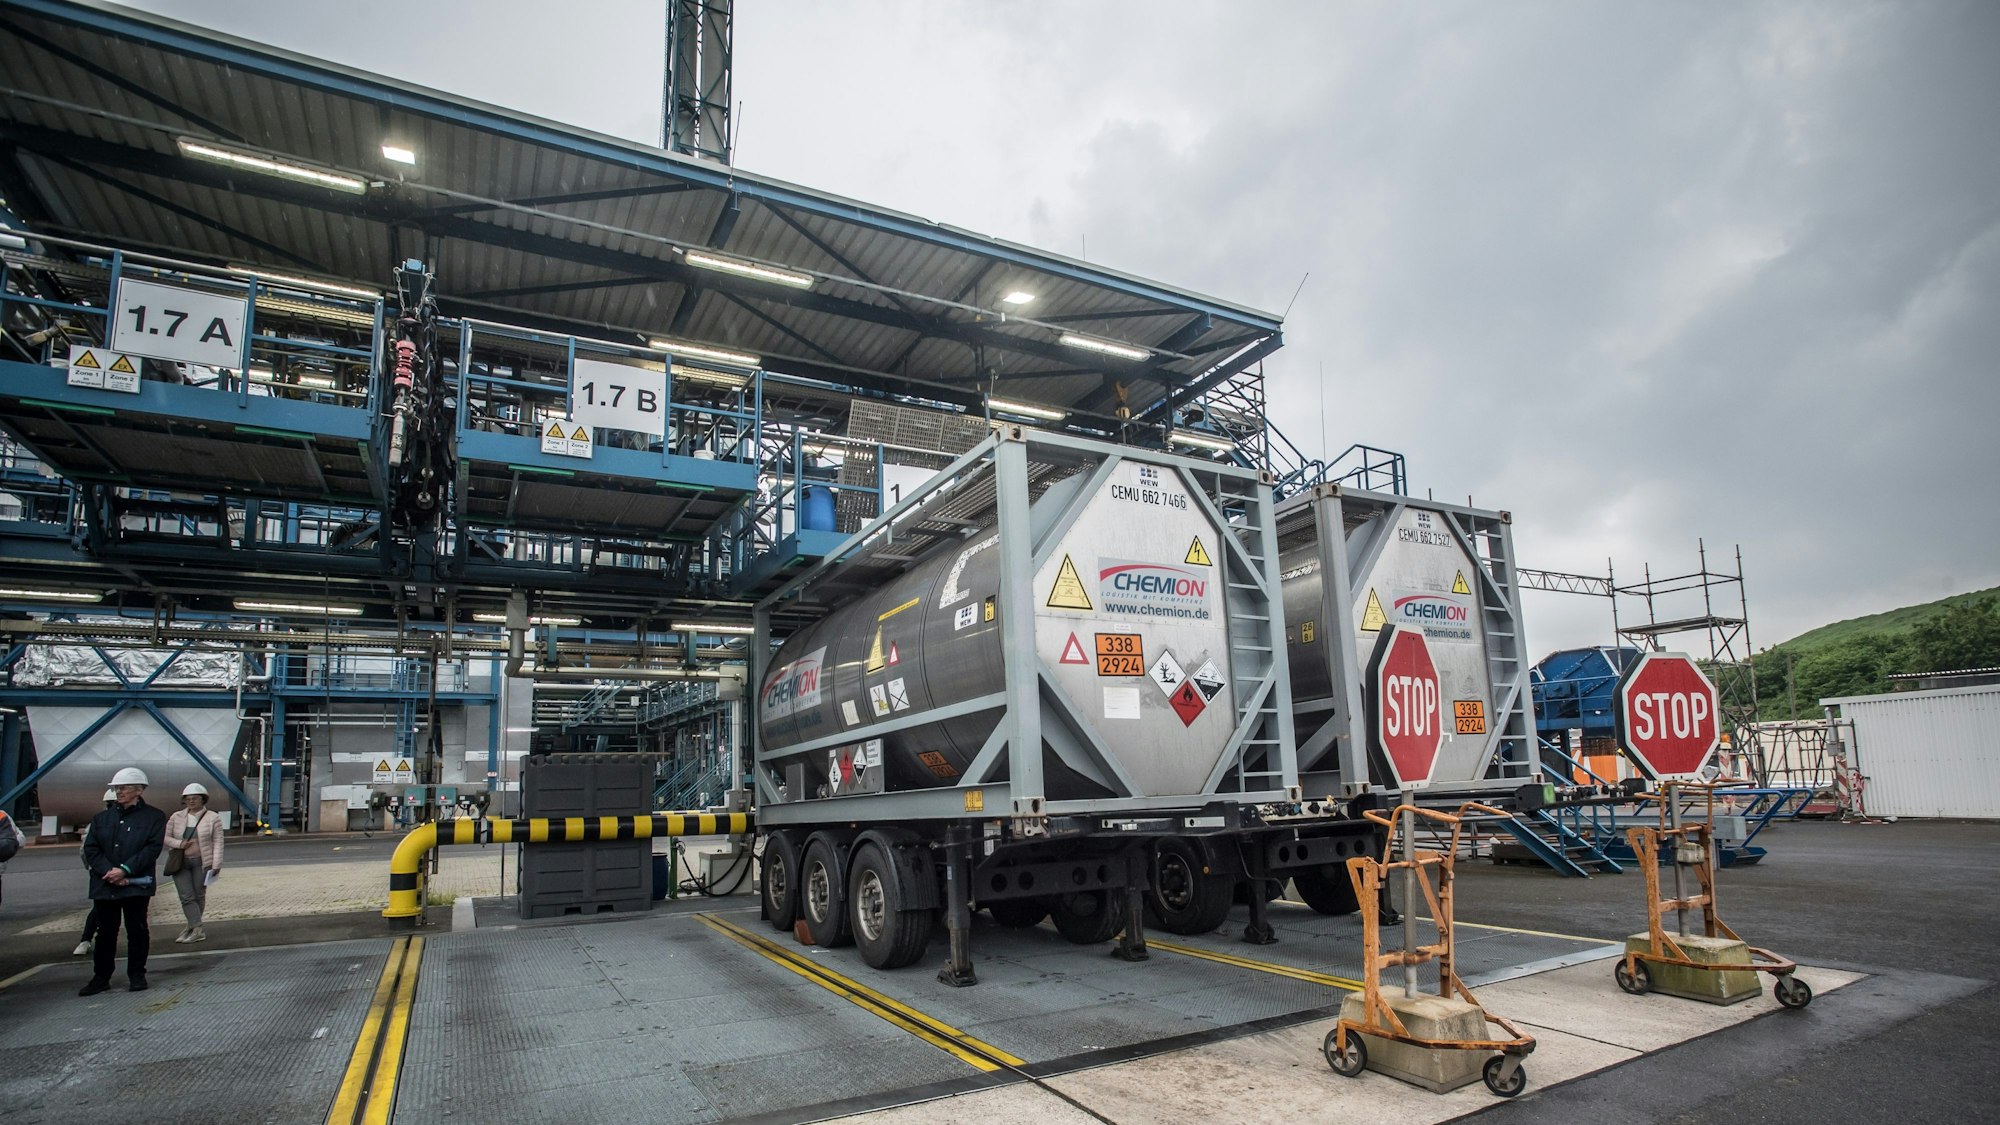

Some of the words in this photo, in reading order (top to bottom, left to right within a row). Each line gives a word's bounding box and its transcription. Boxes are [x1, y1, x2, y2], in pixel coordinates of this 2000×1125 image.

[128, 305, 189, 338] 1.7
[199, 317, 233, 347] A
[74, 369, 93, 377] Zone
[582, 381, 626, 408] 1.7
[637, 388, 658, 413] B
[1139, 478, 1159, 488] WEW
[1111, 484, 1140, 502] CEMU
[1142, 489, 1160, 505] 662
[1399, 528, 1419, 542] CEMU
[1419, 531, 1433, 544] 662
[1433, 534, 1450, 546] 7527
[1113, 572, 1206, 598] CHEMION
[1101, 591, 1139, 600] LOGISTIK
[1105, 602, 1209, 620] www.chemion.de
[1403, 602, 1467, 621] CHEMION
[1424, 625, 1471, 639] chemion.de
[1105, 636, 1134, 653] 338
[1102, 657, 1140, 674] 2924
[767, 665, 820, 709] CHEMION
[1386, 674, 1436, 737] STOP
[1459, 703, 1479, 716] 338
[1634, 691, 1708, 741] STOP
[1458, 719, 1483, 732] 2924
